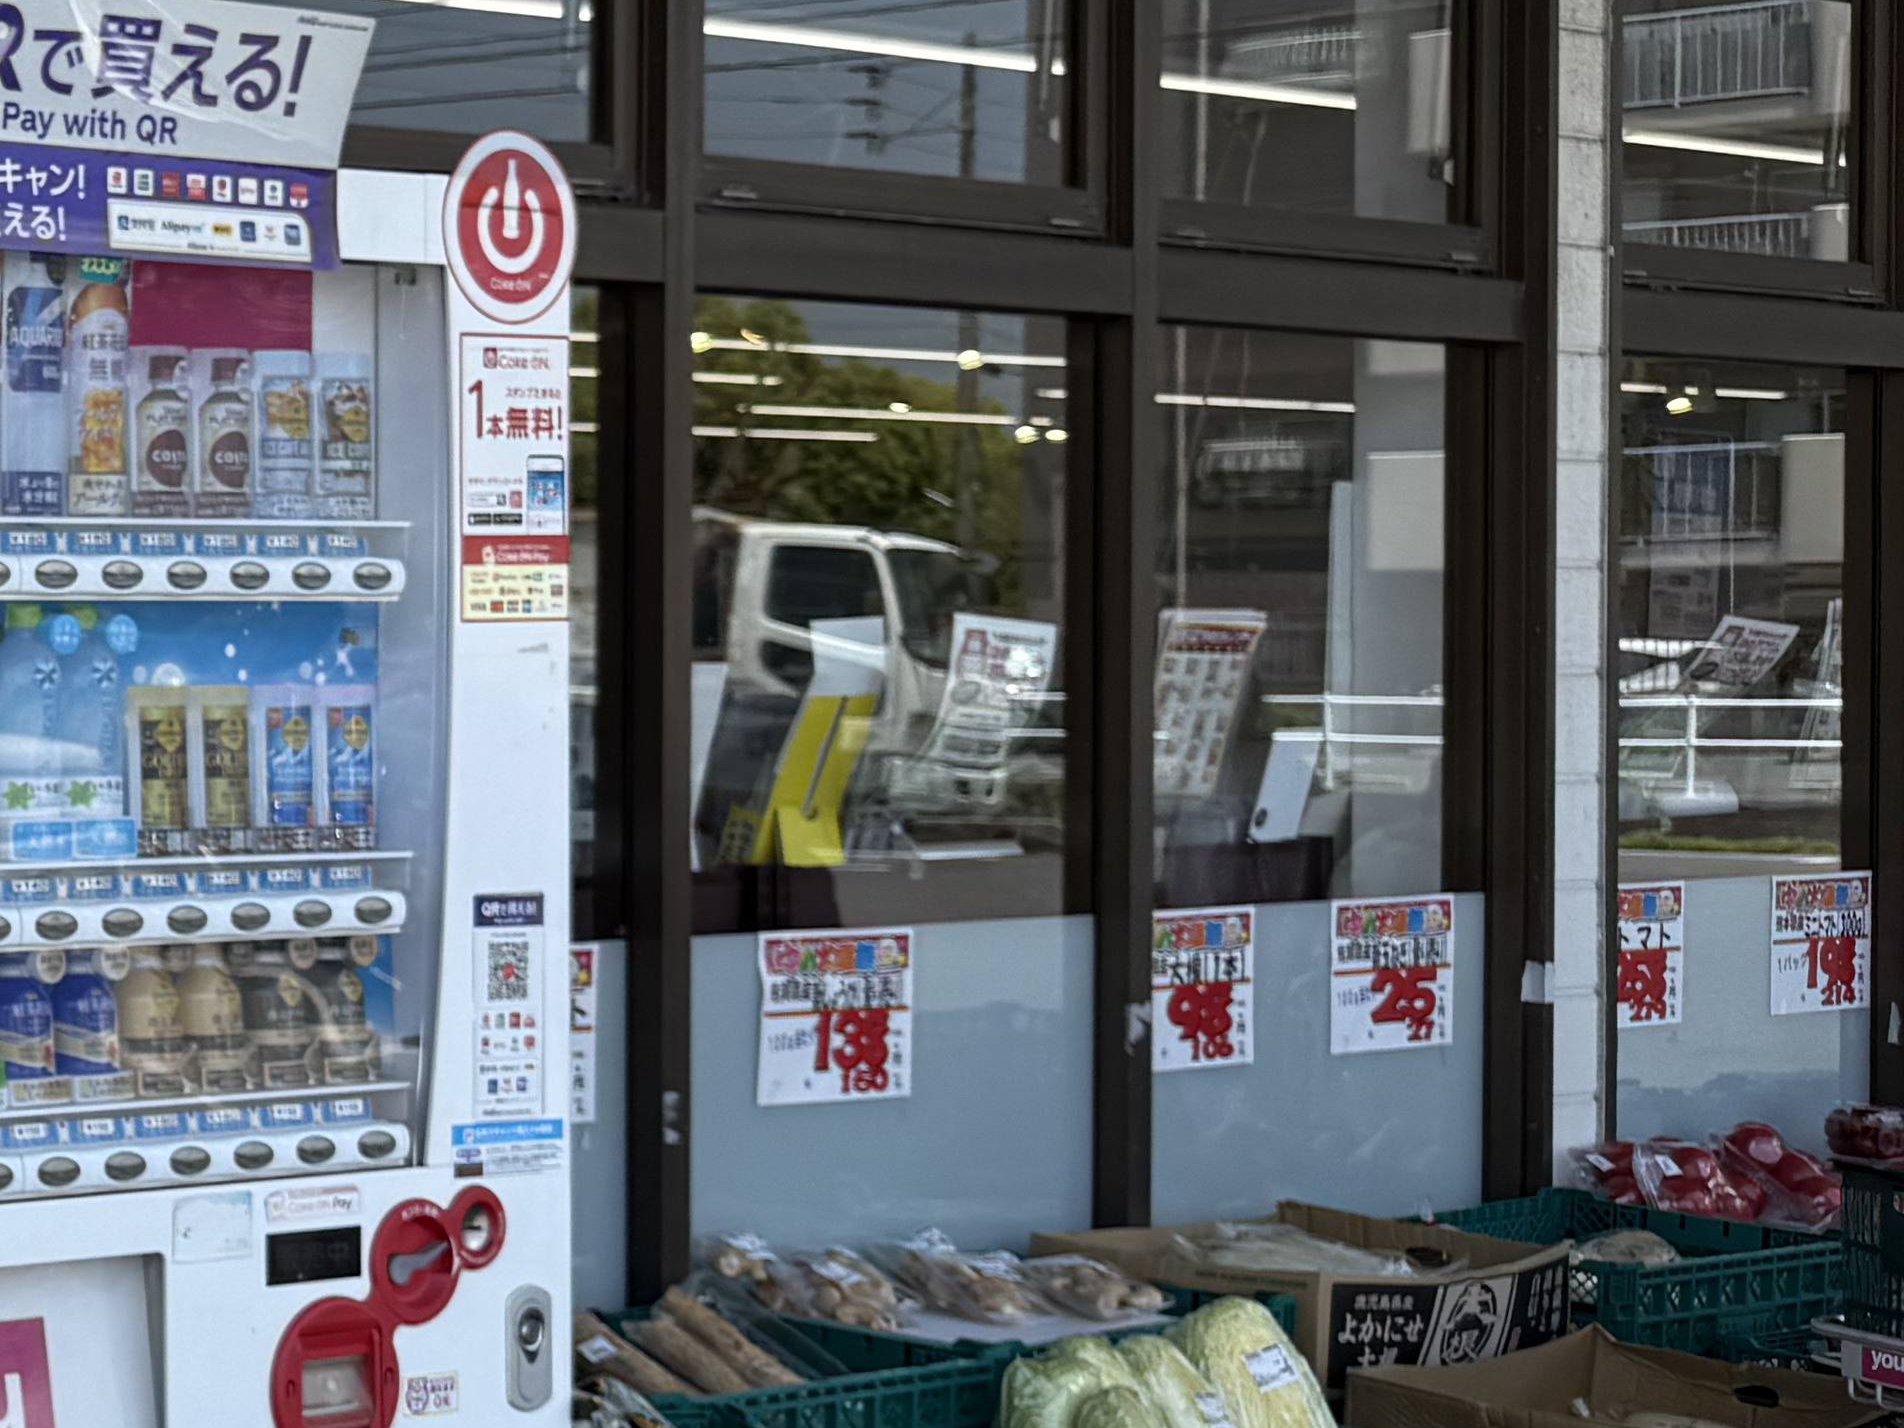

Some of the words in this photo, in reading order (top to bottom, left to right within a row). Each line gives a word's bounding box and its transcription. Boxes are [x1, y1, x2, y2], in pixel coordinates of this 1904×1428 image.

[3, 101, 54, 140] Pay
[63, 109, 126, 142] with
[137, 115, 177, 145] QR
[1338, 1312, 1424, 1345] よかにせ
